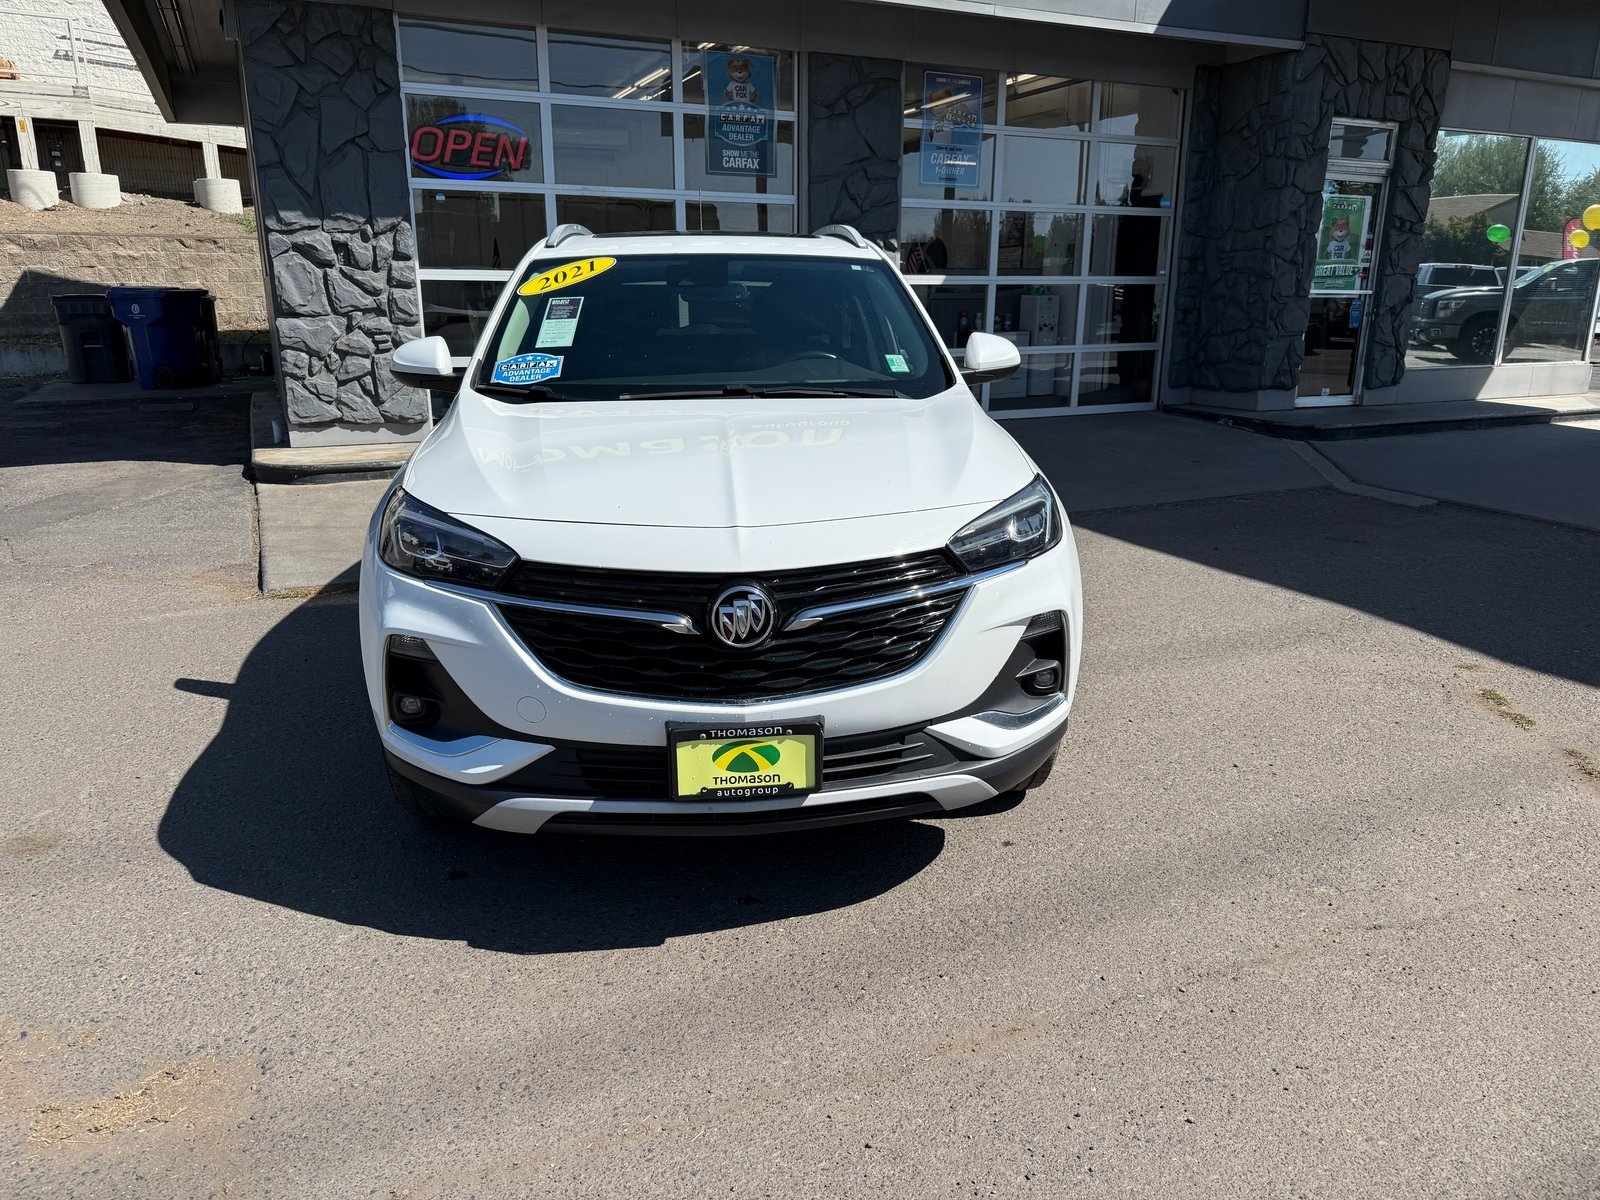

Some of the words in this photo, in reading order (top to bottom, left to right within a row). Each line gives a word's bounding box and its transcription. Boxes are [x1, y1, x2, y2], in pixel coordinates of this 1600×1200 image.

[720, 113, 765, 125] CARFAX
[722, 124, 761, 134] ADVANTAGE
[728, 133, 754, 141] DEALER
[411, 126, 528, 170] OPEN
[722, 149, 739, 157] SHOW
[722, 157, 760, 169] CARFAX
[539, 260, 596, 291] 2021
[500, 361, 557, 370] CARFAX
[502, 368, 551, 377] ADVANTAGE
[510, 374, 542, 382] DEALER
[717, 786, 779, 797] autogroup
